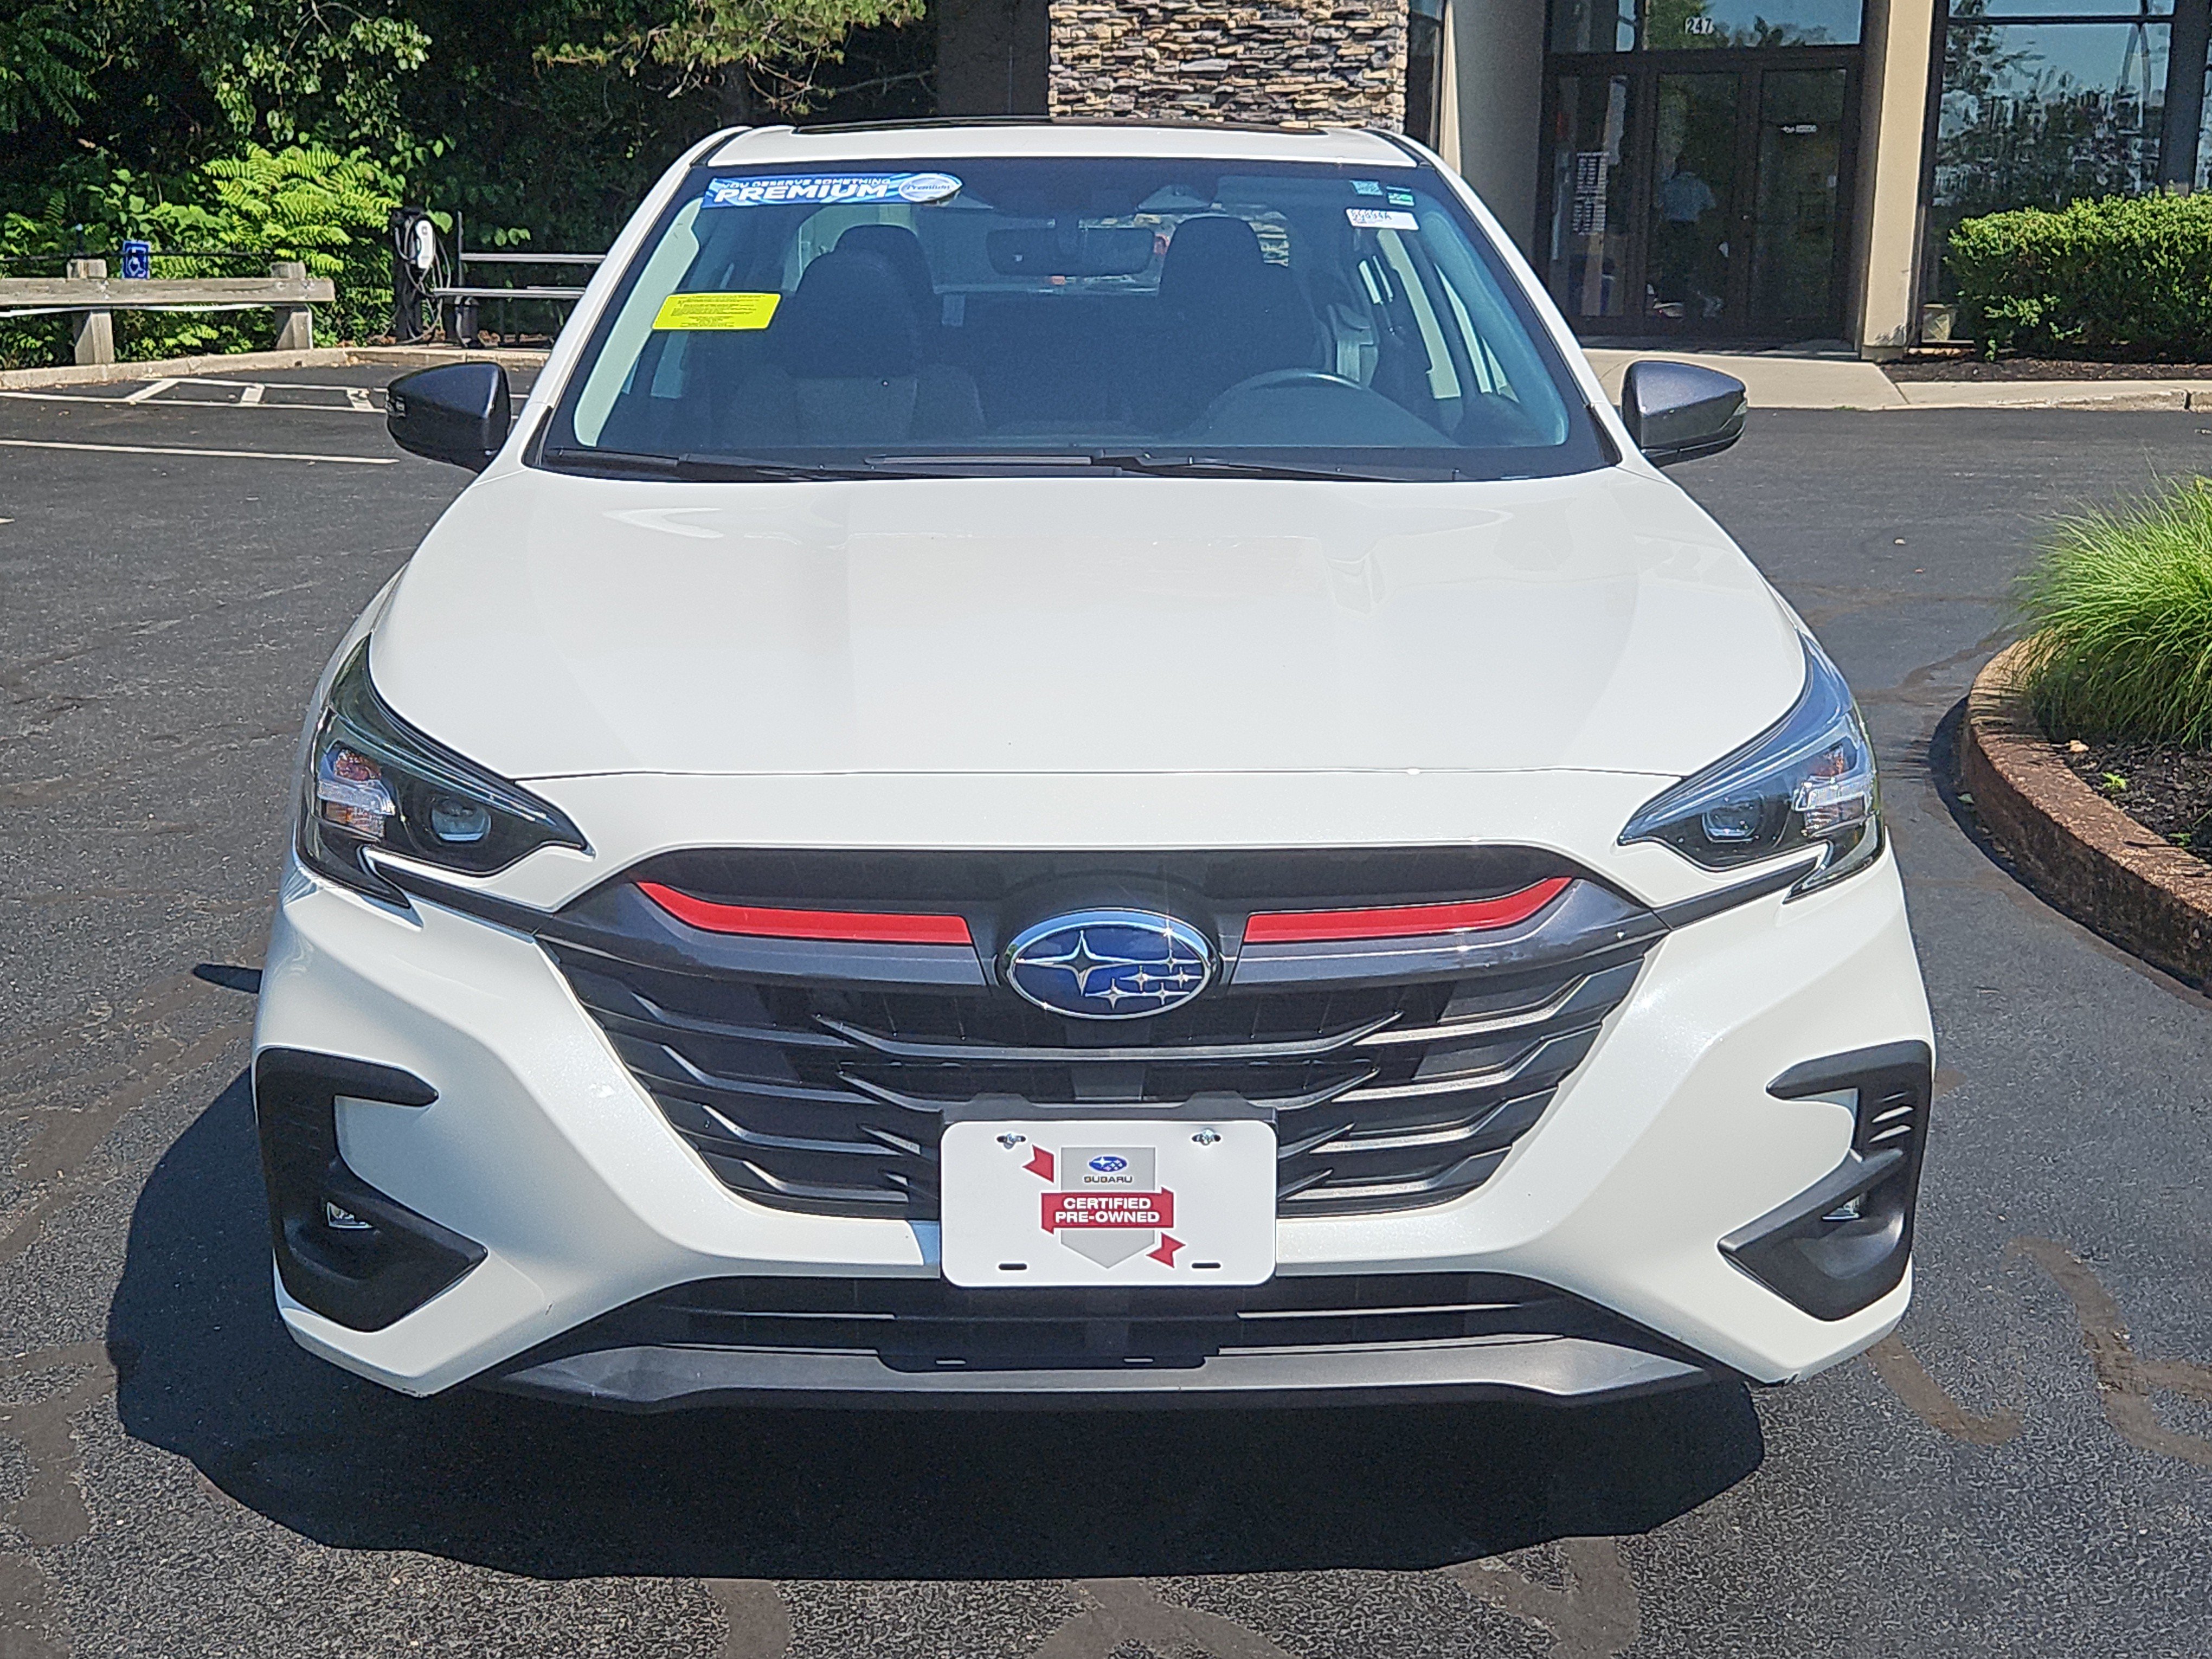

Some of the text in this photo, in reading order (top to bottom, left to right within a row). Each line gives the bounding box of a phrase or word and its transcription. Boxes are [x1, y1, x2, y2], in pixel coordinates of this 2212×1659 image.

[1687, 18, 1712, 33] 247
[752, 179, 812, 187] DESERVE
[714, 184, 888, 203] PREMIUM
[1084, 1175, 1133, 1184] SUBARU
[1063, 1197, 1152, 1210] CERTIFIED
[1055, 1211, 1160, 1224] PRE-OWNED
